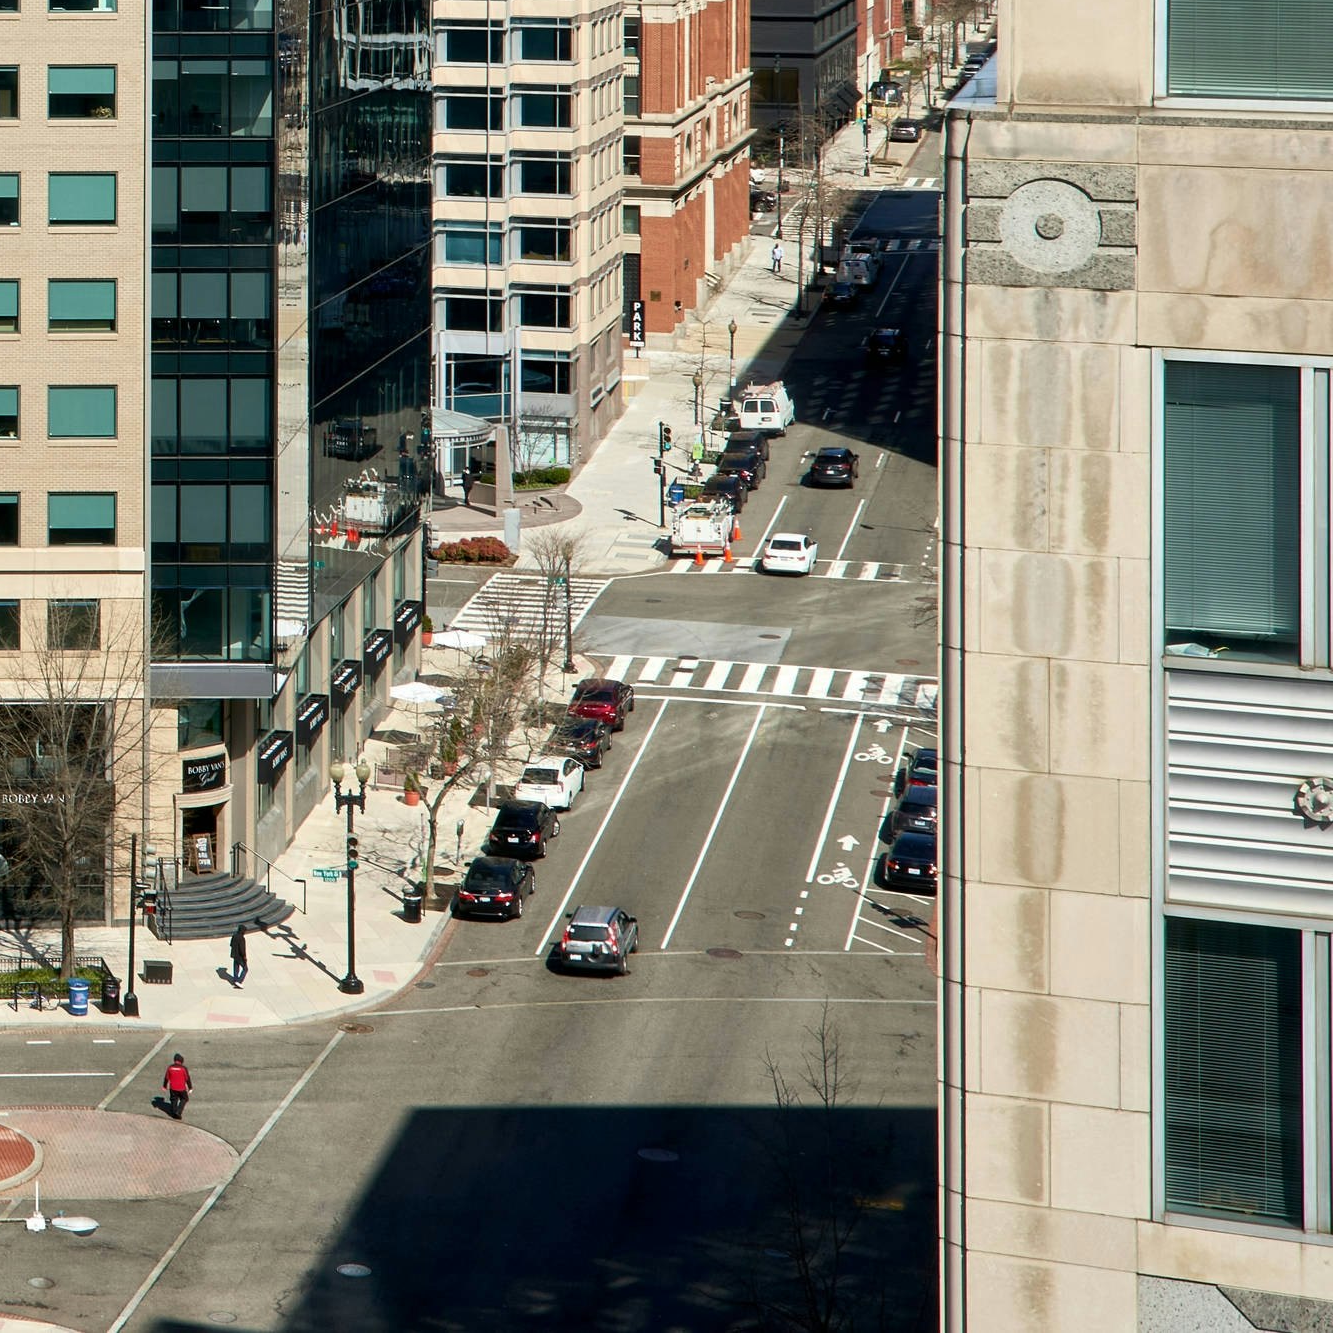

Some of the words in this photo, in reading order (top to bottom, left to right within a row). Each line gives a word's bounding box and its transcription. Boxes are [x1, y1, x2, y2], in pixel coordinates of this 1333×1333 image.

[633, 302, 642, 341] PARK
[187, 765, 210, 775] BOBBY
[2, 793, 39, 804] BOBBY
